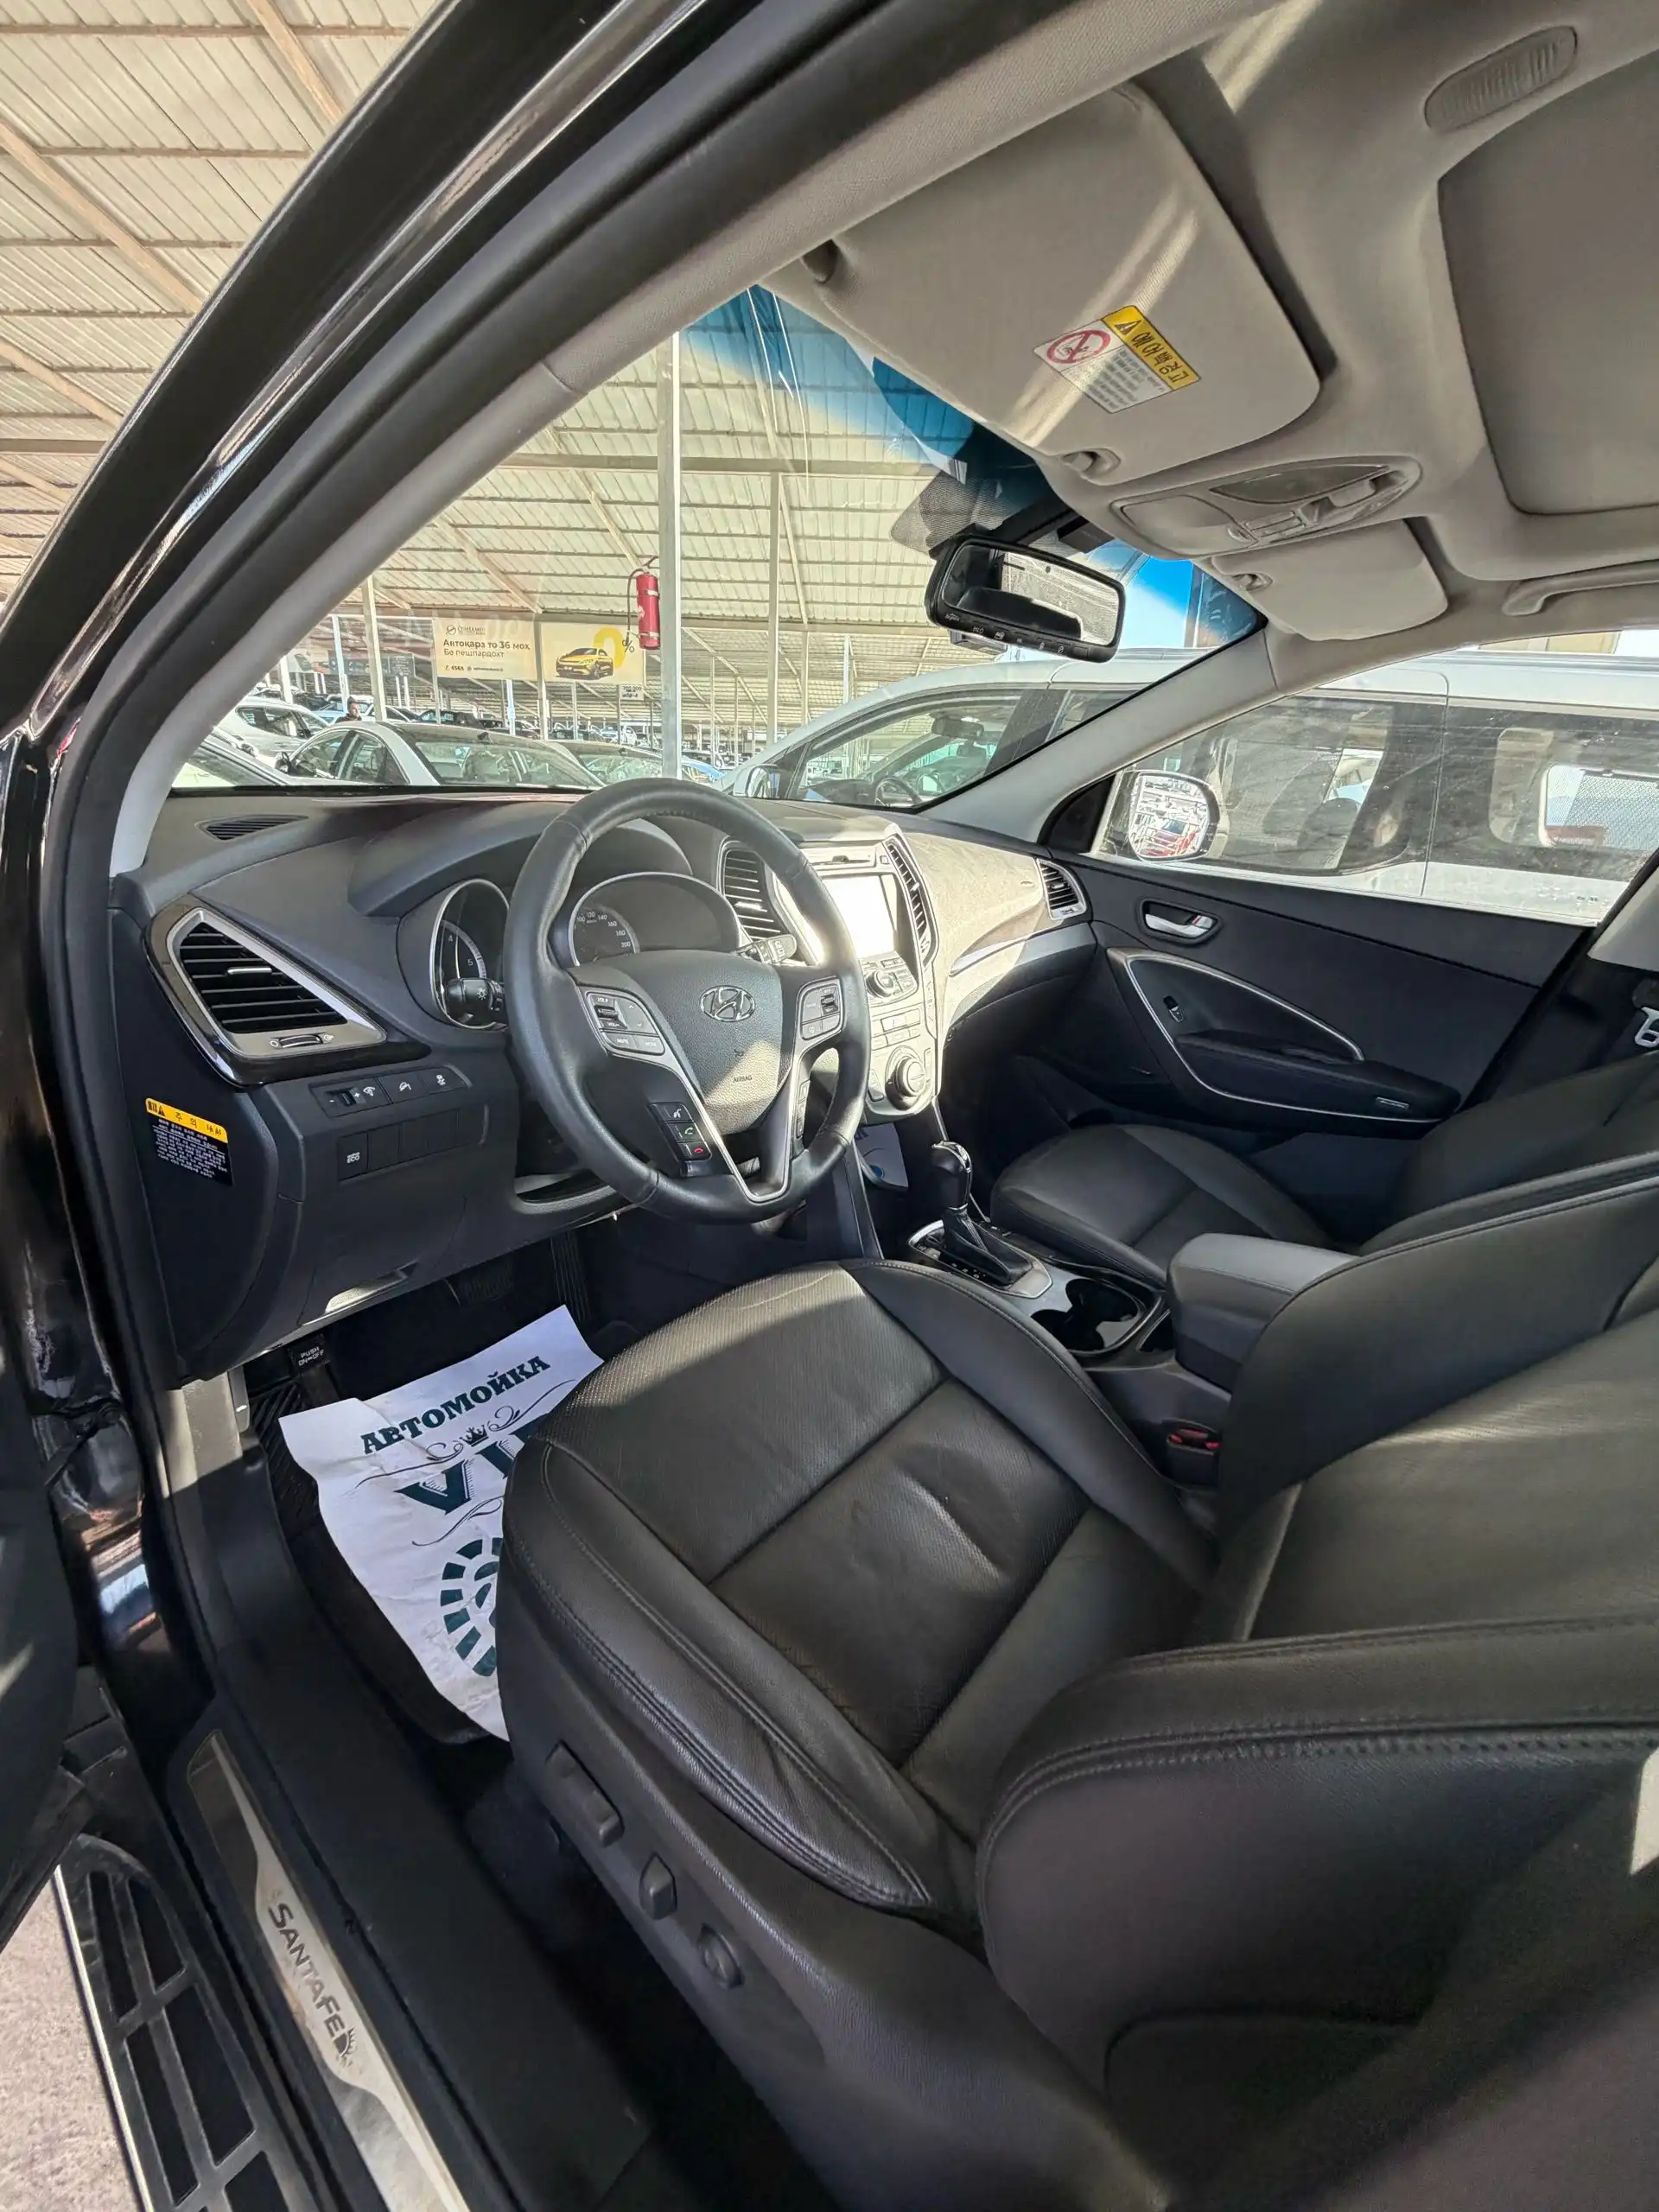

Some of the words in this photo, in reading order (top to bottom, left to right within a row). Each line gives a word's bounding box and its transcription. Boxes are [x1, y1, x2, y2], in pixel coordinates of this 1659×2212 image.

[346, 1154, 360, 1164] ECO
[300, 1346, 320, 1358] PUSH
[360, 1355, 551, 1455] АВТОМОЙКА
